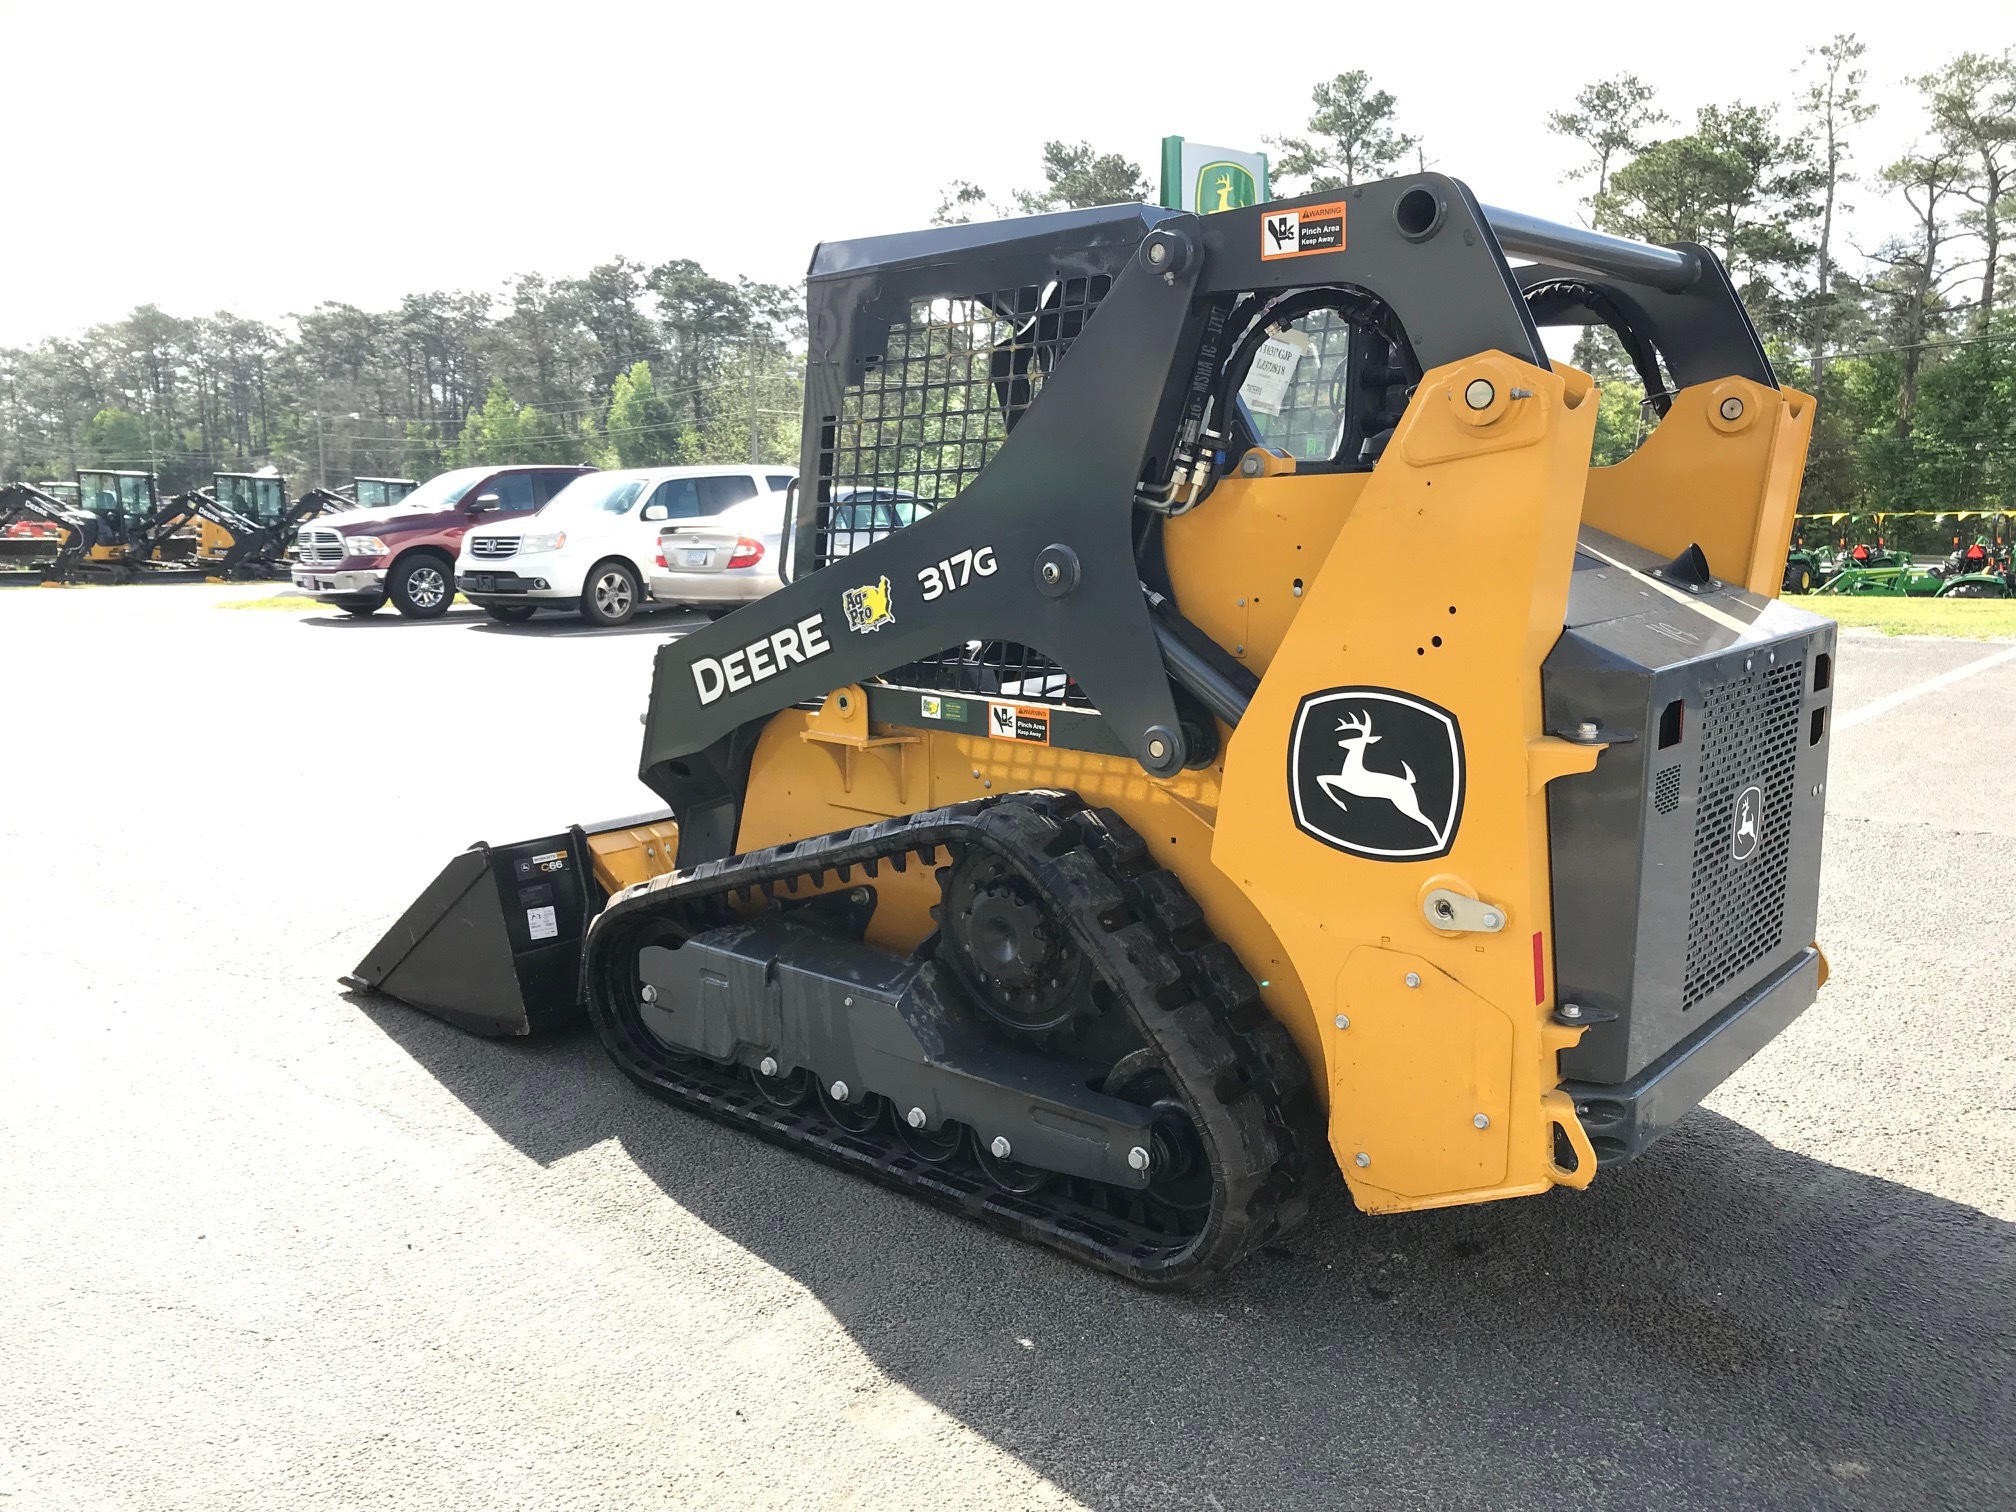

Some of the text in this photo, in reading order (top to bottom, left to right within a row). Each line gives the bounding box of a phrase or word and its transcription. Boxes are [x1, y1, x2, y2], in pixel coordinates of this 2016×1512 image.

[1309, 207, 1341, 217] WARNING
[1301, 225, 1340, 236] Pinch Area
[1193, 360, 1214, 393] MSHA
[25, 500, 48, 517] DEERE
[198, 506, 221, 523] DEERE
[917, 546, 998, 601] 317G
[846, 592, 867, 611] Ag-
[849, 606, 872, 626] Pro
[690, 613, 831, 706] DEERE
[1017, 721, 1046, 731] Pinch Area
[541, 860, 563, 871] C66
